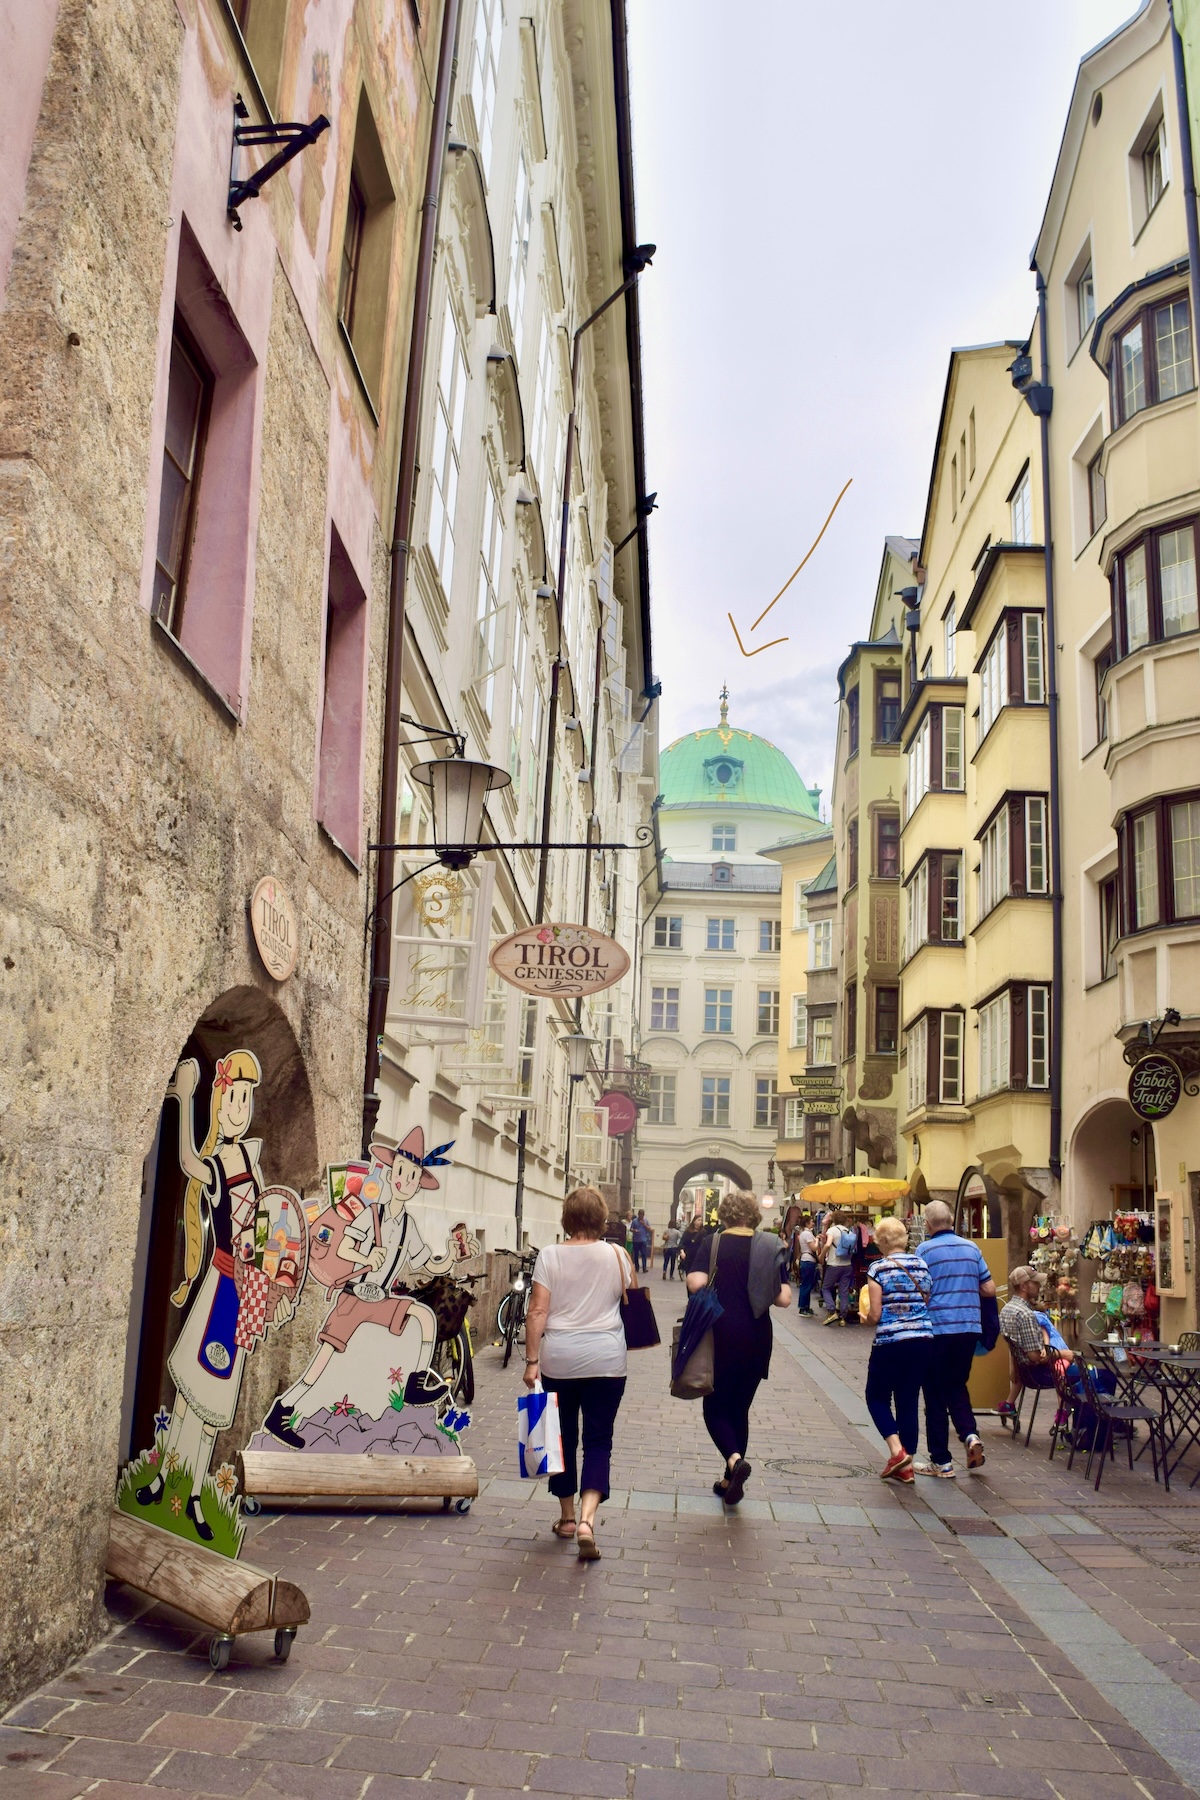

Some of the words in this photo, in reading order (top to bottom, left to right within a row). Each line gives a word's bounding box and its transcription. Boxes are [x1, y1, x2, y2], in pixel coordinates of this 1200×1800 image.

[430, 891, 443, 911] S
[261, 896, 292, 949] TIROL
[514, 943, 609, 968] TIROL
[514, 966, 607, 981] GENIESSEN
[795, 1077, 830, 1085] Souvenir
[1133, 1068, 1178, 1090] Tabak
[803, 1088, 838, 1096] Geschenke
[1132, 1087, 1176, 1107] Trafik
[359, 1285, 380, 1296] TIROL
[210, 1345, 227, 1362] TIROL
